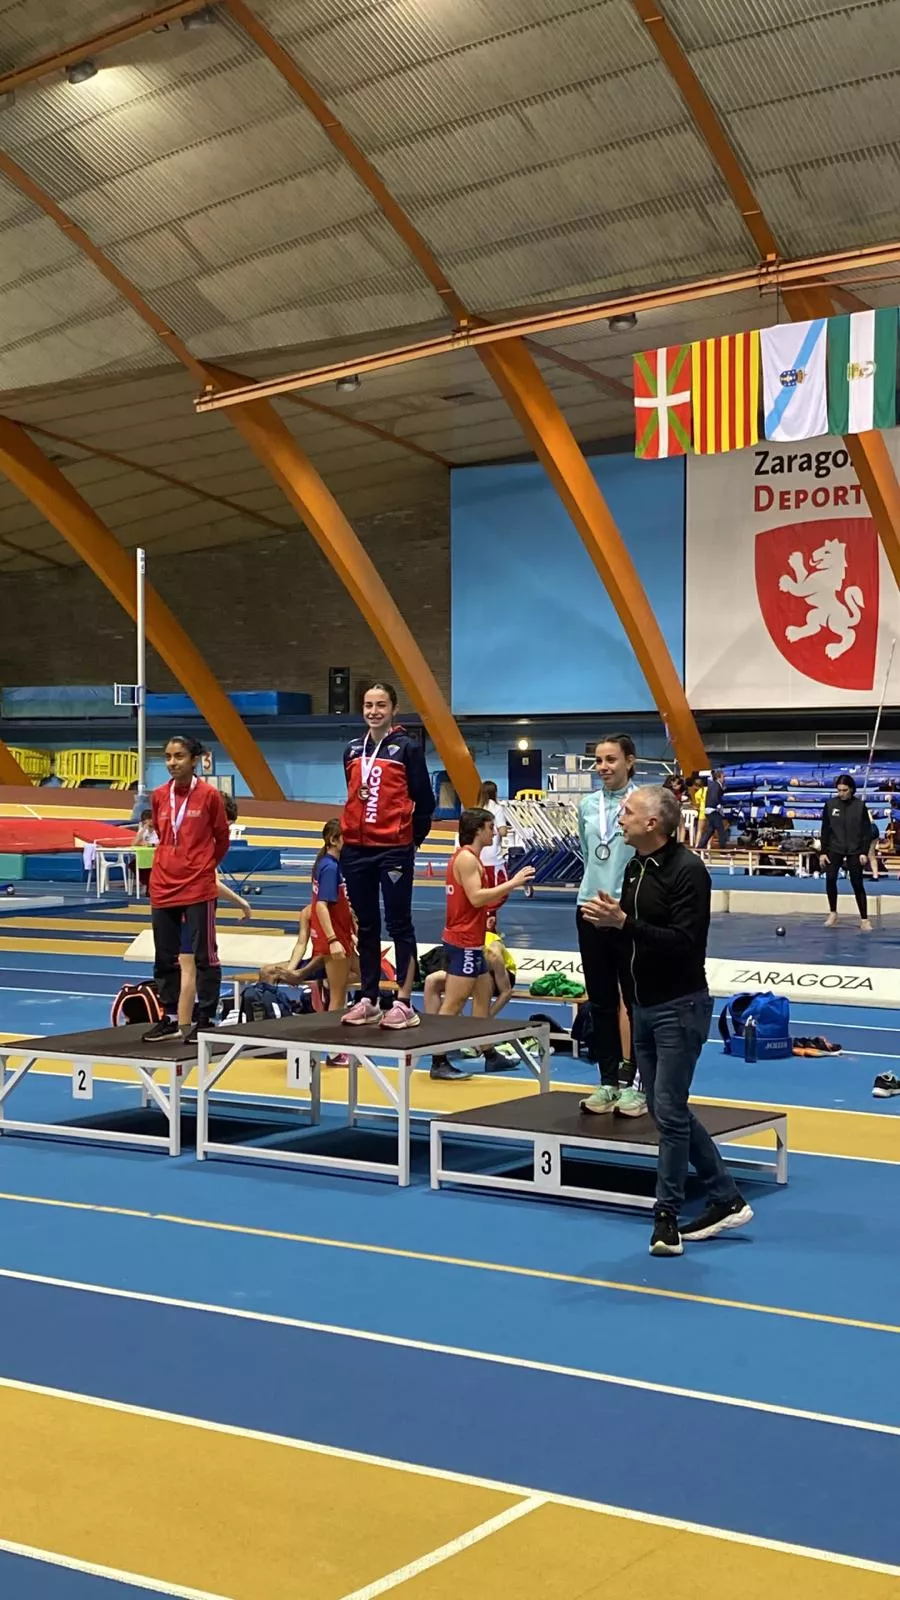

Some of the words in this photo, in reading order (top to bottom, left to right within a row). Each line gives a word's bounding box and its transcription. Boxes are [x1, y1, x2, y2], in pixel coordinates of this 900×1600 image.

[754, 449, 853, 478] Zarago
[203, 752, 212, 770] 3
[547, 774, 555, 791] N
[365, 765, 383, 824] HINACO
[730, 969, 874, 991] ZARAGOZA
[294, 1057, 300, 1080] 1
[77, 1069, 87, 1091] 2
[541, 1150, 552, 1176] 3
